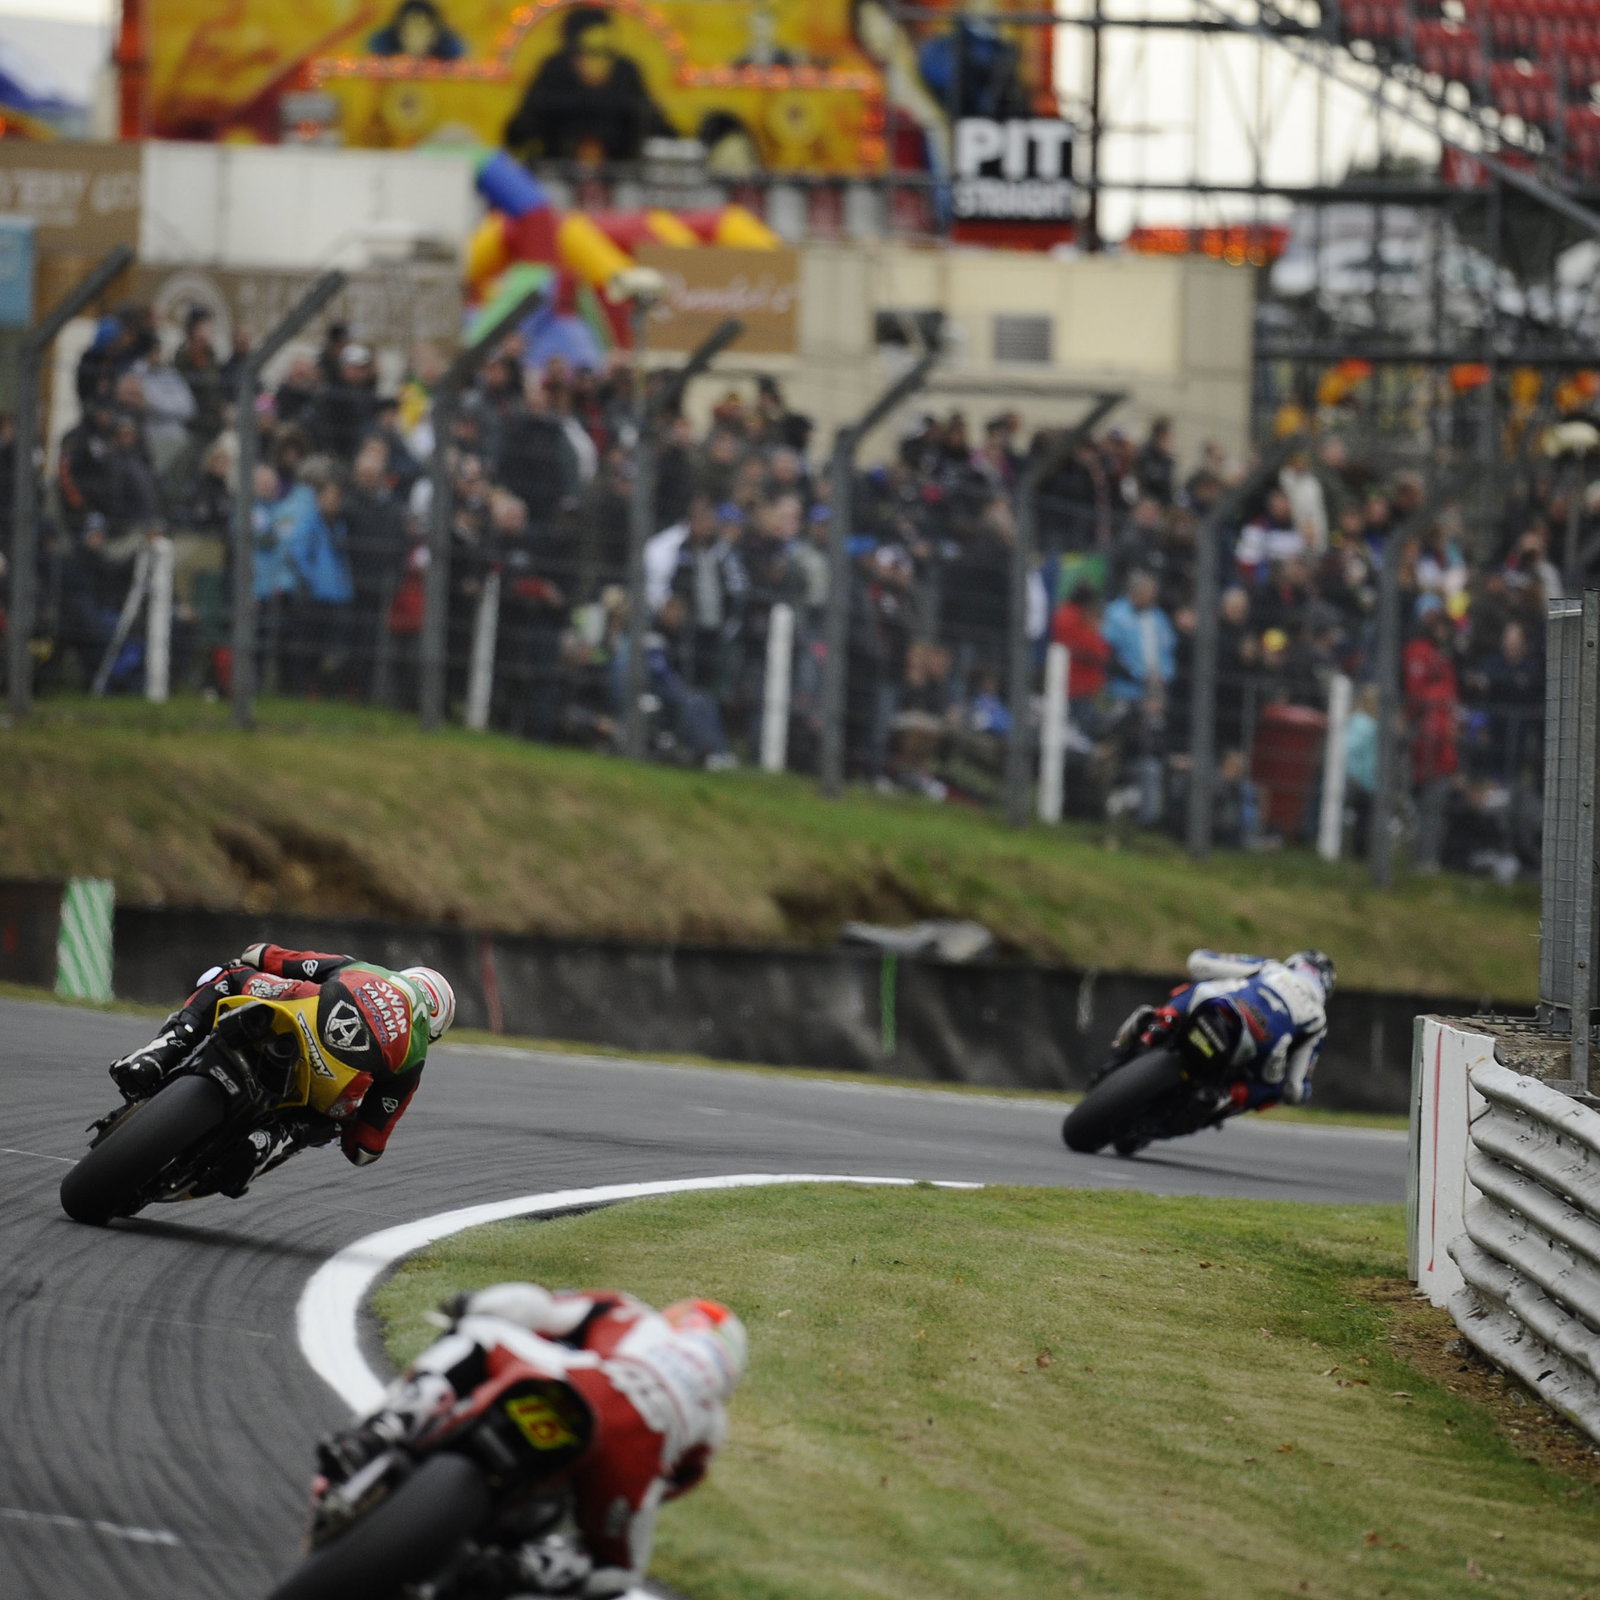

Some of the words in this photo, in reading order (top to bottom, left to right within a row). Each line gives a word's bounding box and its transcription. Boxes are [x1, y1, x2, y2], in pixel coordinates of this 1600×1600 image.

[955, 117, 1073, 178] PIT
[361, 982, 399, 1042] YAMAHA
[374, 981, 408, 1035] SWAN
